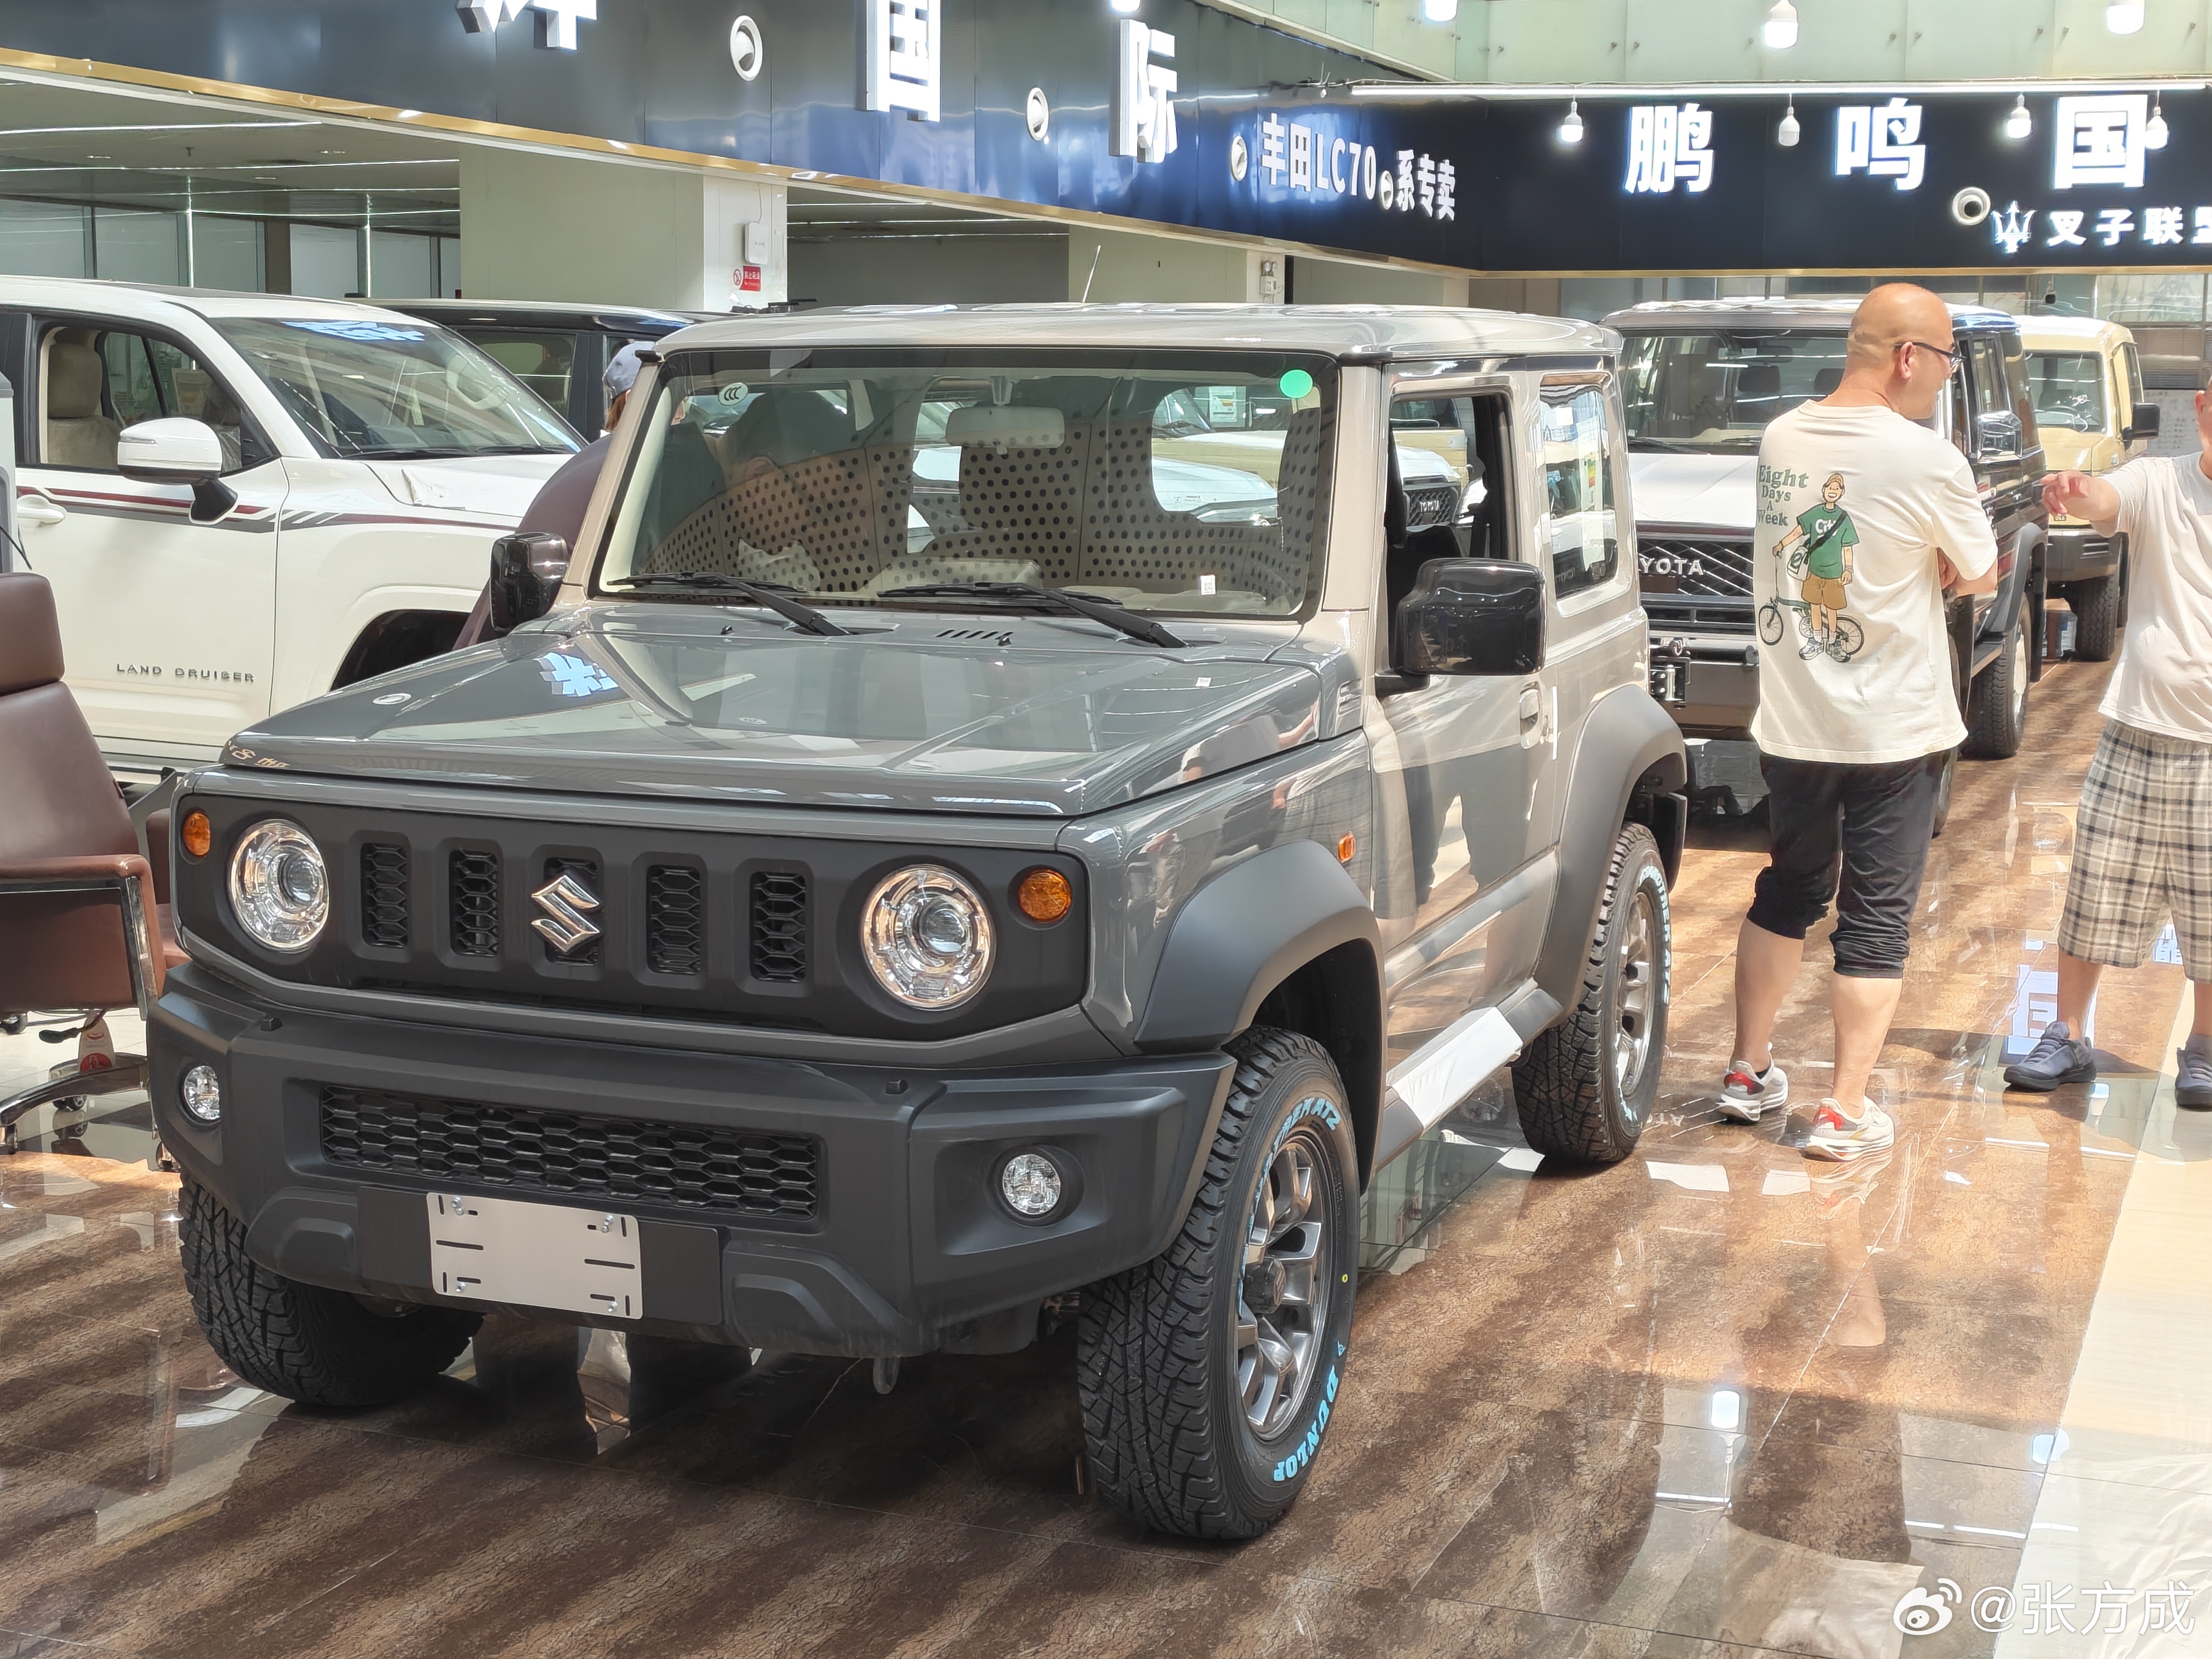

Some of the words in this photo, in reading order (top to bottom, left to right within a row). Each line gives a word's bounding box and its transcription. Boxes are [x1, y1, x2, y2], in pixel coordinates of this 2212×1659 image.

[1759, 464, 1809, 489] Eight
[1762, 484, 1791, 503] Days
[1766, 500, 1773, 511] A
[1640, 558, 1704, 576] YOTA
[117, 663, 161, 675] LAND
[1273, 1364, 1339, 1481] DUNLOP
